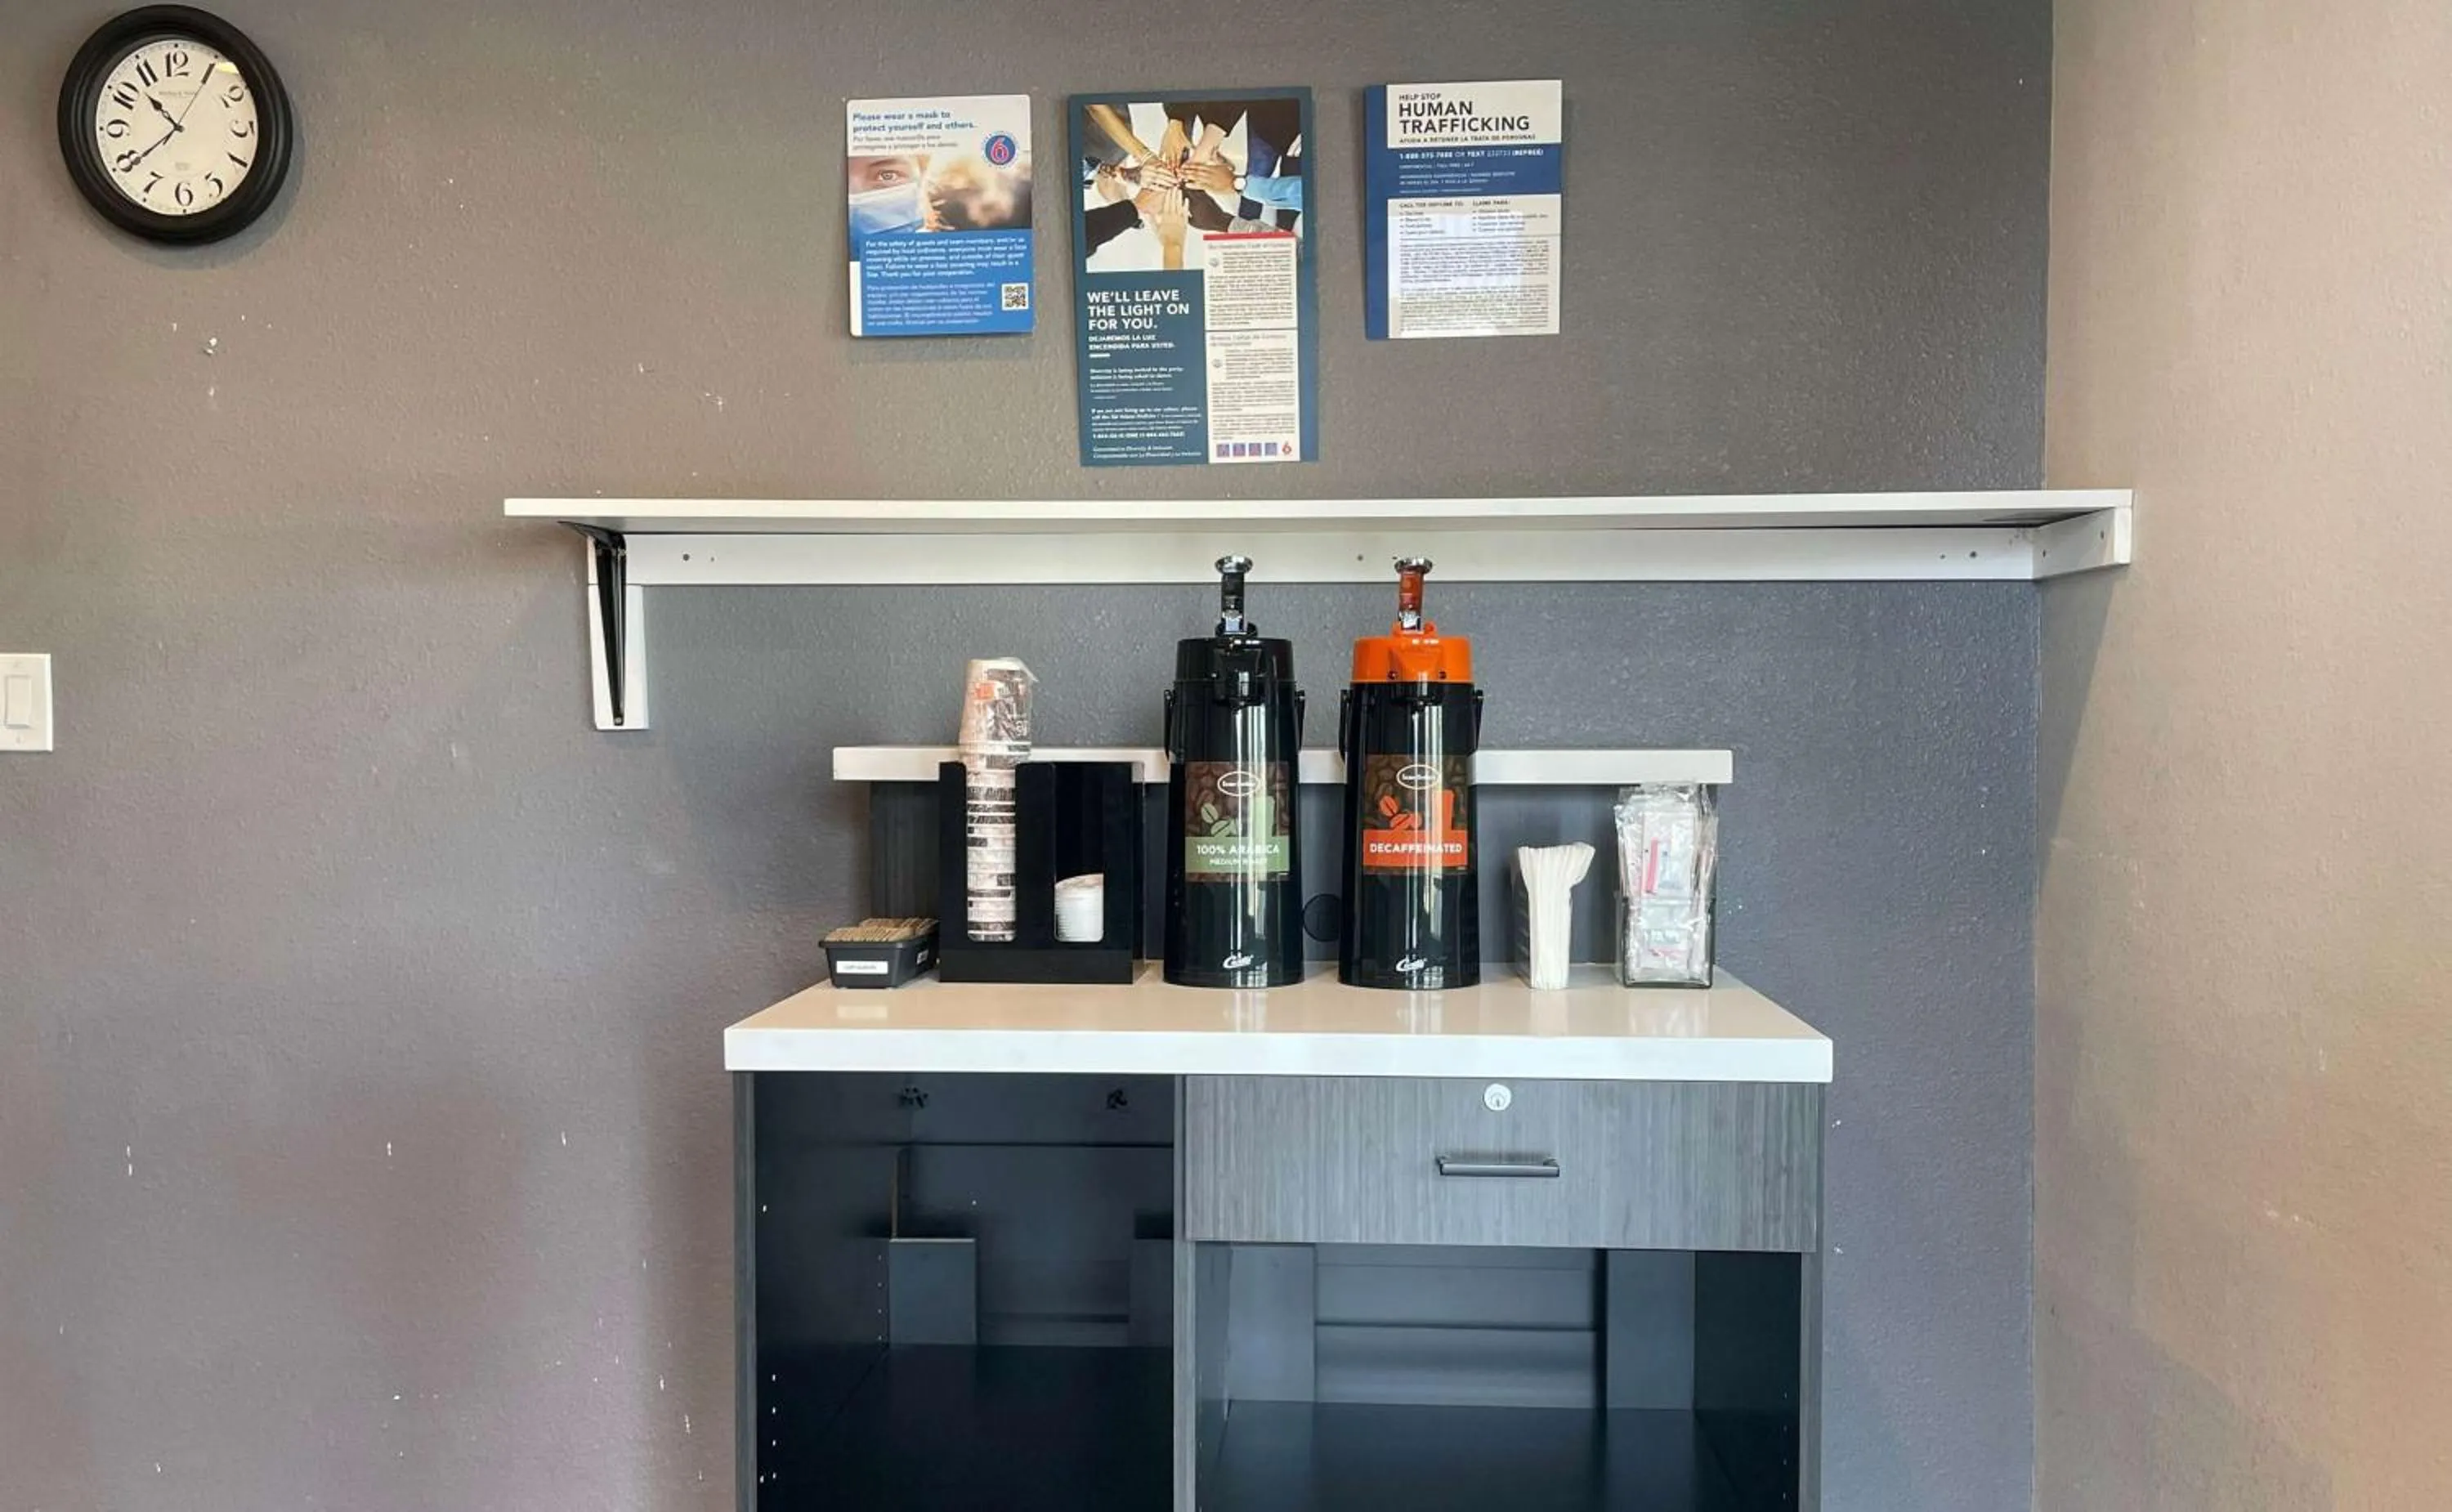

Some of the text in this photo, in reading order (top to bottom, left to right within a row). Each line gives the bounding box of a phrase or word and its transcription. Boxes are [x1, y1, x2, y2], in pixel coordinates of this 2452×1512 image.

[165, 51, 189, 77] 12
[136, 60, 159, 87] 11
[113, 82, 140, 110] 10
[1421, 92, 1442, 101] STOP
[915, 110, 938, 119] mask
[941, 110, 951, 119] to
[1398, 101, 1473, 117] HUMAN
[106, 119, 129, 138] 9
[852, 123, 885, 132] protect
[888, 122, 925, 132] yourself
[926, 122, 942, 130] and
[1398, 115, 1530, 134] TRAFFICKING
[116, 150, 141, 172] 8
[144, 171, 163, 194] 7
[205, 172, 223, 198] 5
[174, 181, 193, 206] 6
[1087, 289, 1179, 303] WE'LL LEAVE
[1087, 303, 1189, 317] THE LIGHT ON
[1088, 317, 1158, 330] FOR YOU.
[1197, 844, 1226, 855] 100%
[1369, 843, 1463, 853] DECAFFEINATED
